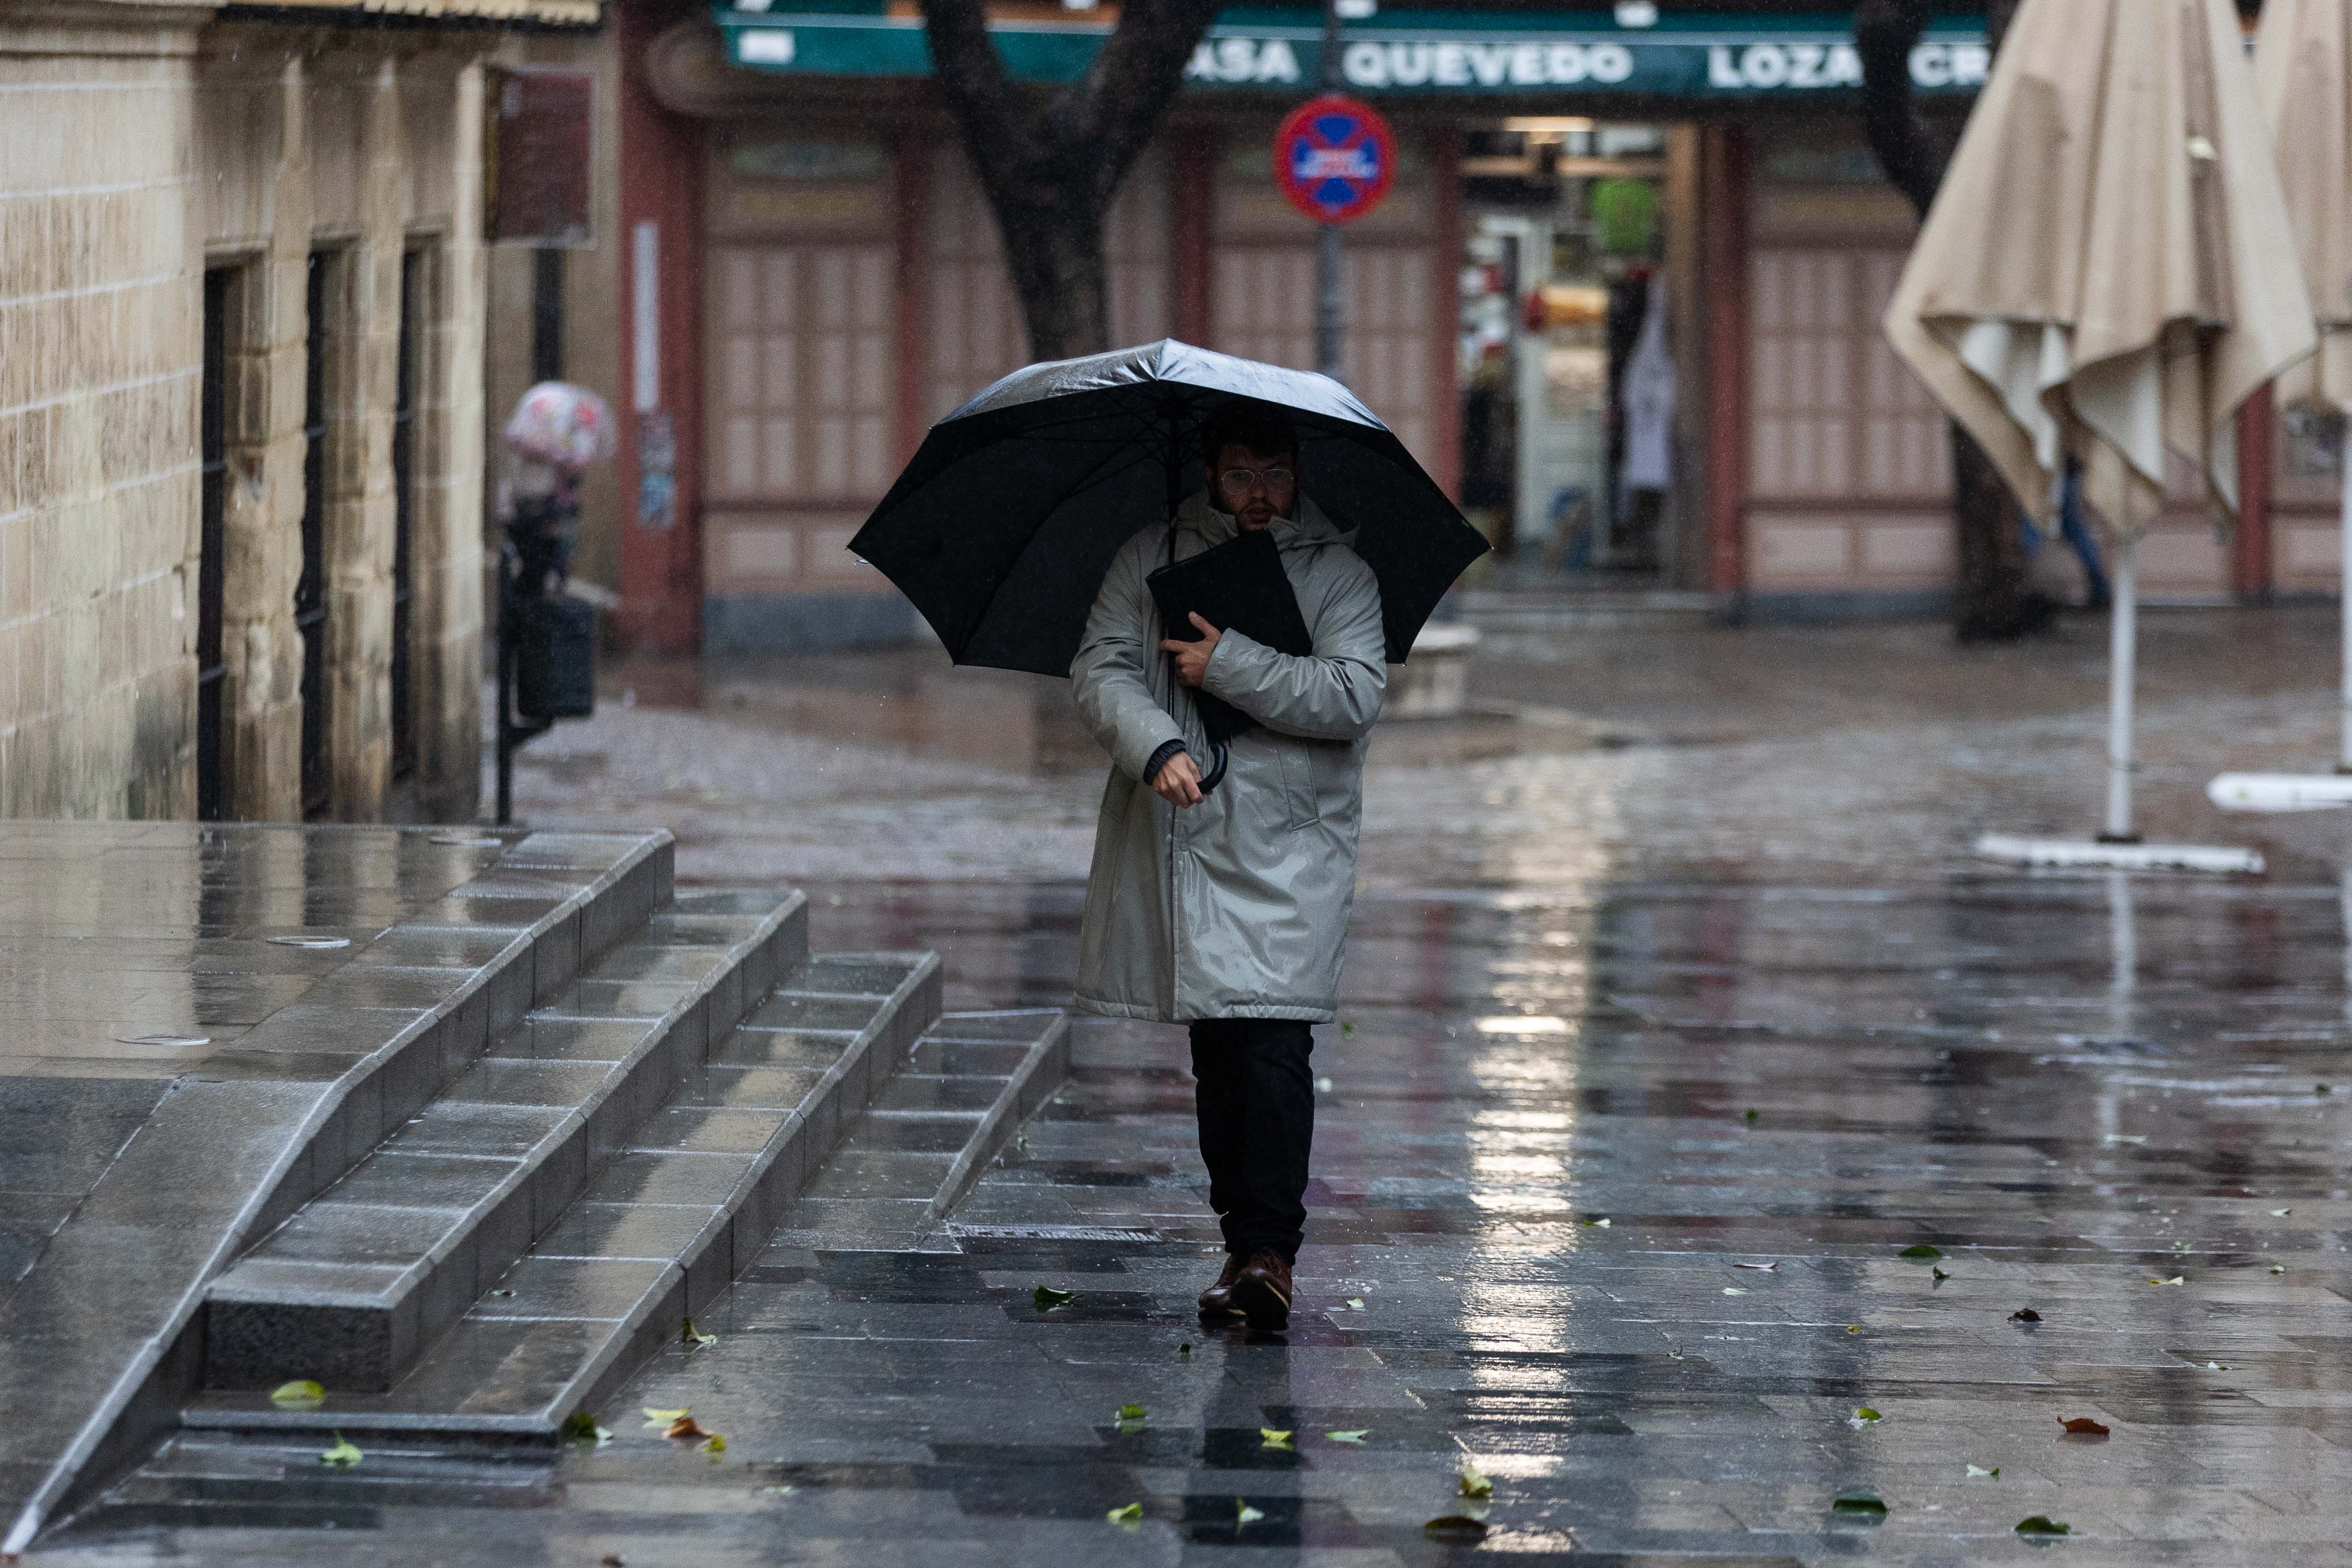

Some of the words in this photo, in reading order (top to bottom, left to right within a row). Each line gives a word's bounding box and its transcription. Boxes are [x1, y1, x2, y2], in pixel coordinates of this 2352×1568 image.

[1184, 39, 1301, 82] ASA
[1343, 42, 1633, 87] QUEVEDO
[1908, 45, 1989, 86] CR
